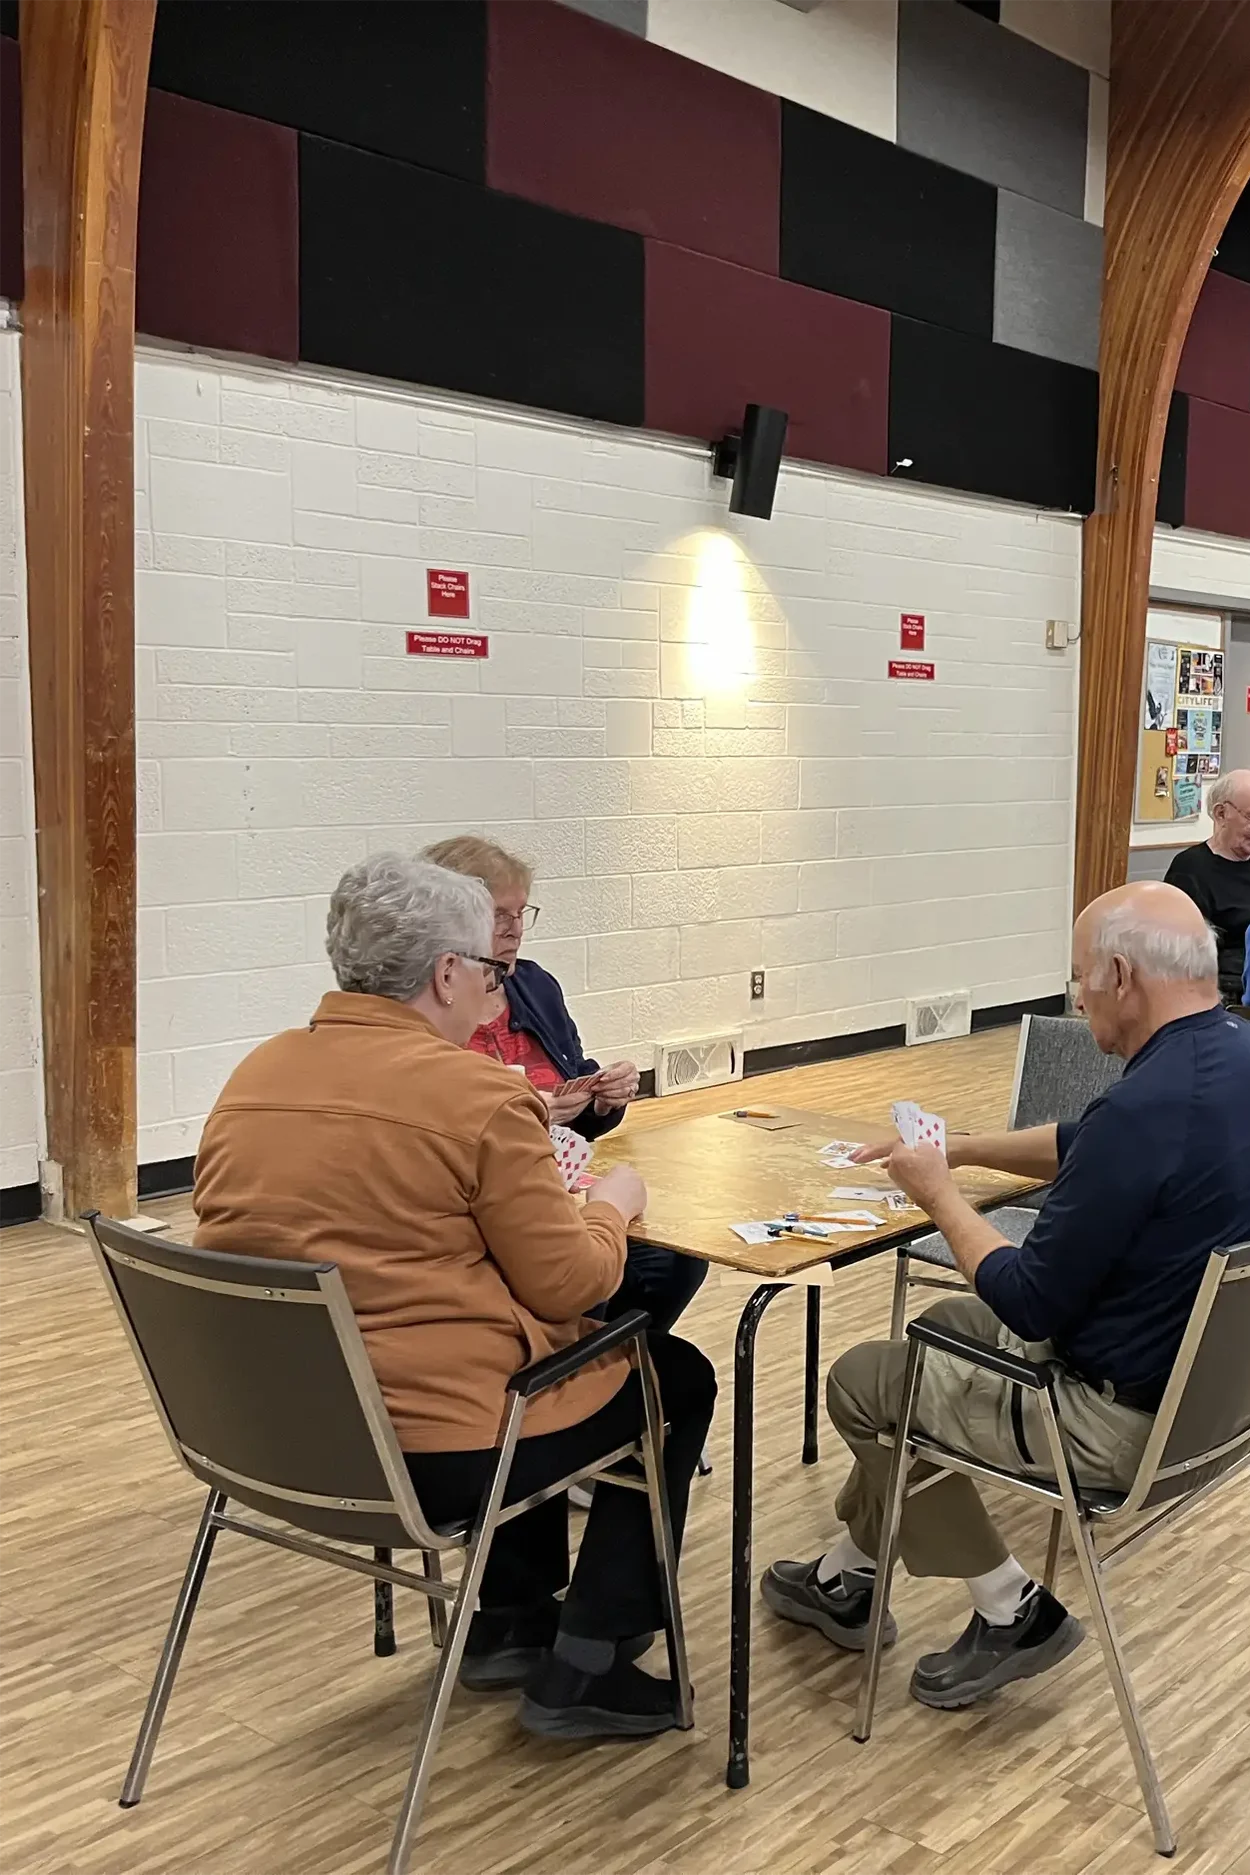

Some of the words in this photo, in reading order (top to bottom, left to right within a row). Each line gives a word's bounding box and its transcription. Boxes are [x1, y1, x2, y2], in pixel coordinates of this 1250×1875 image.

[438, 574, 457, 583] Please
[447, 583, 465, 591] Chairs
[414, 634, 436, 642] Please
[466, 638, 482, 646] Drag
[421, 645, 440, 653] Table
[454, 647, 475, 655] Chairs
[1177, 696, 1212, 705] CITYLIFE
